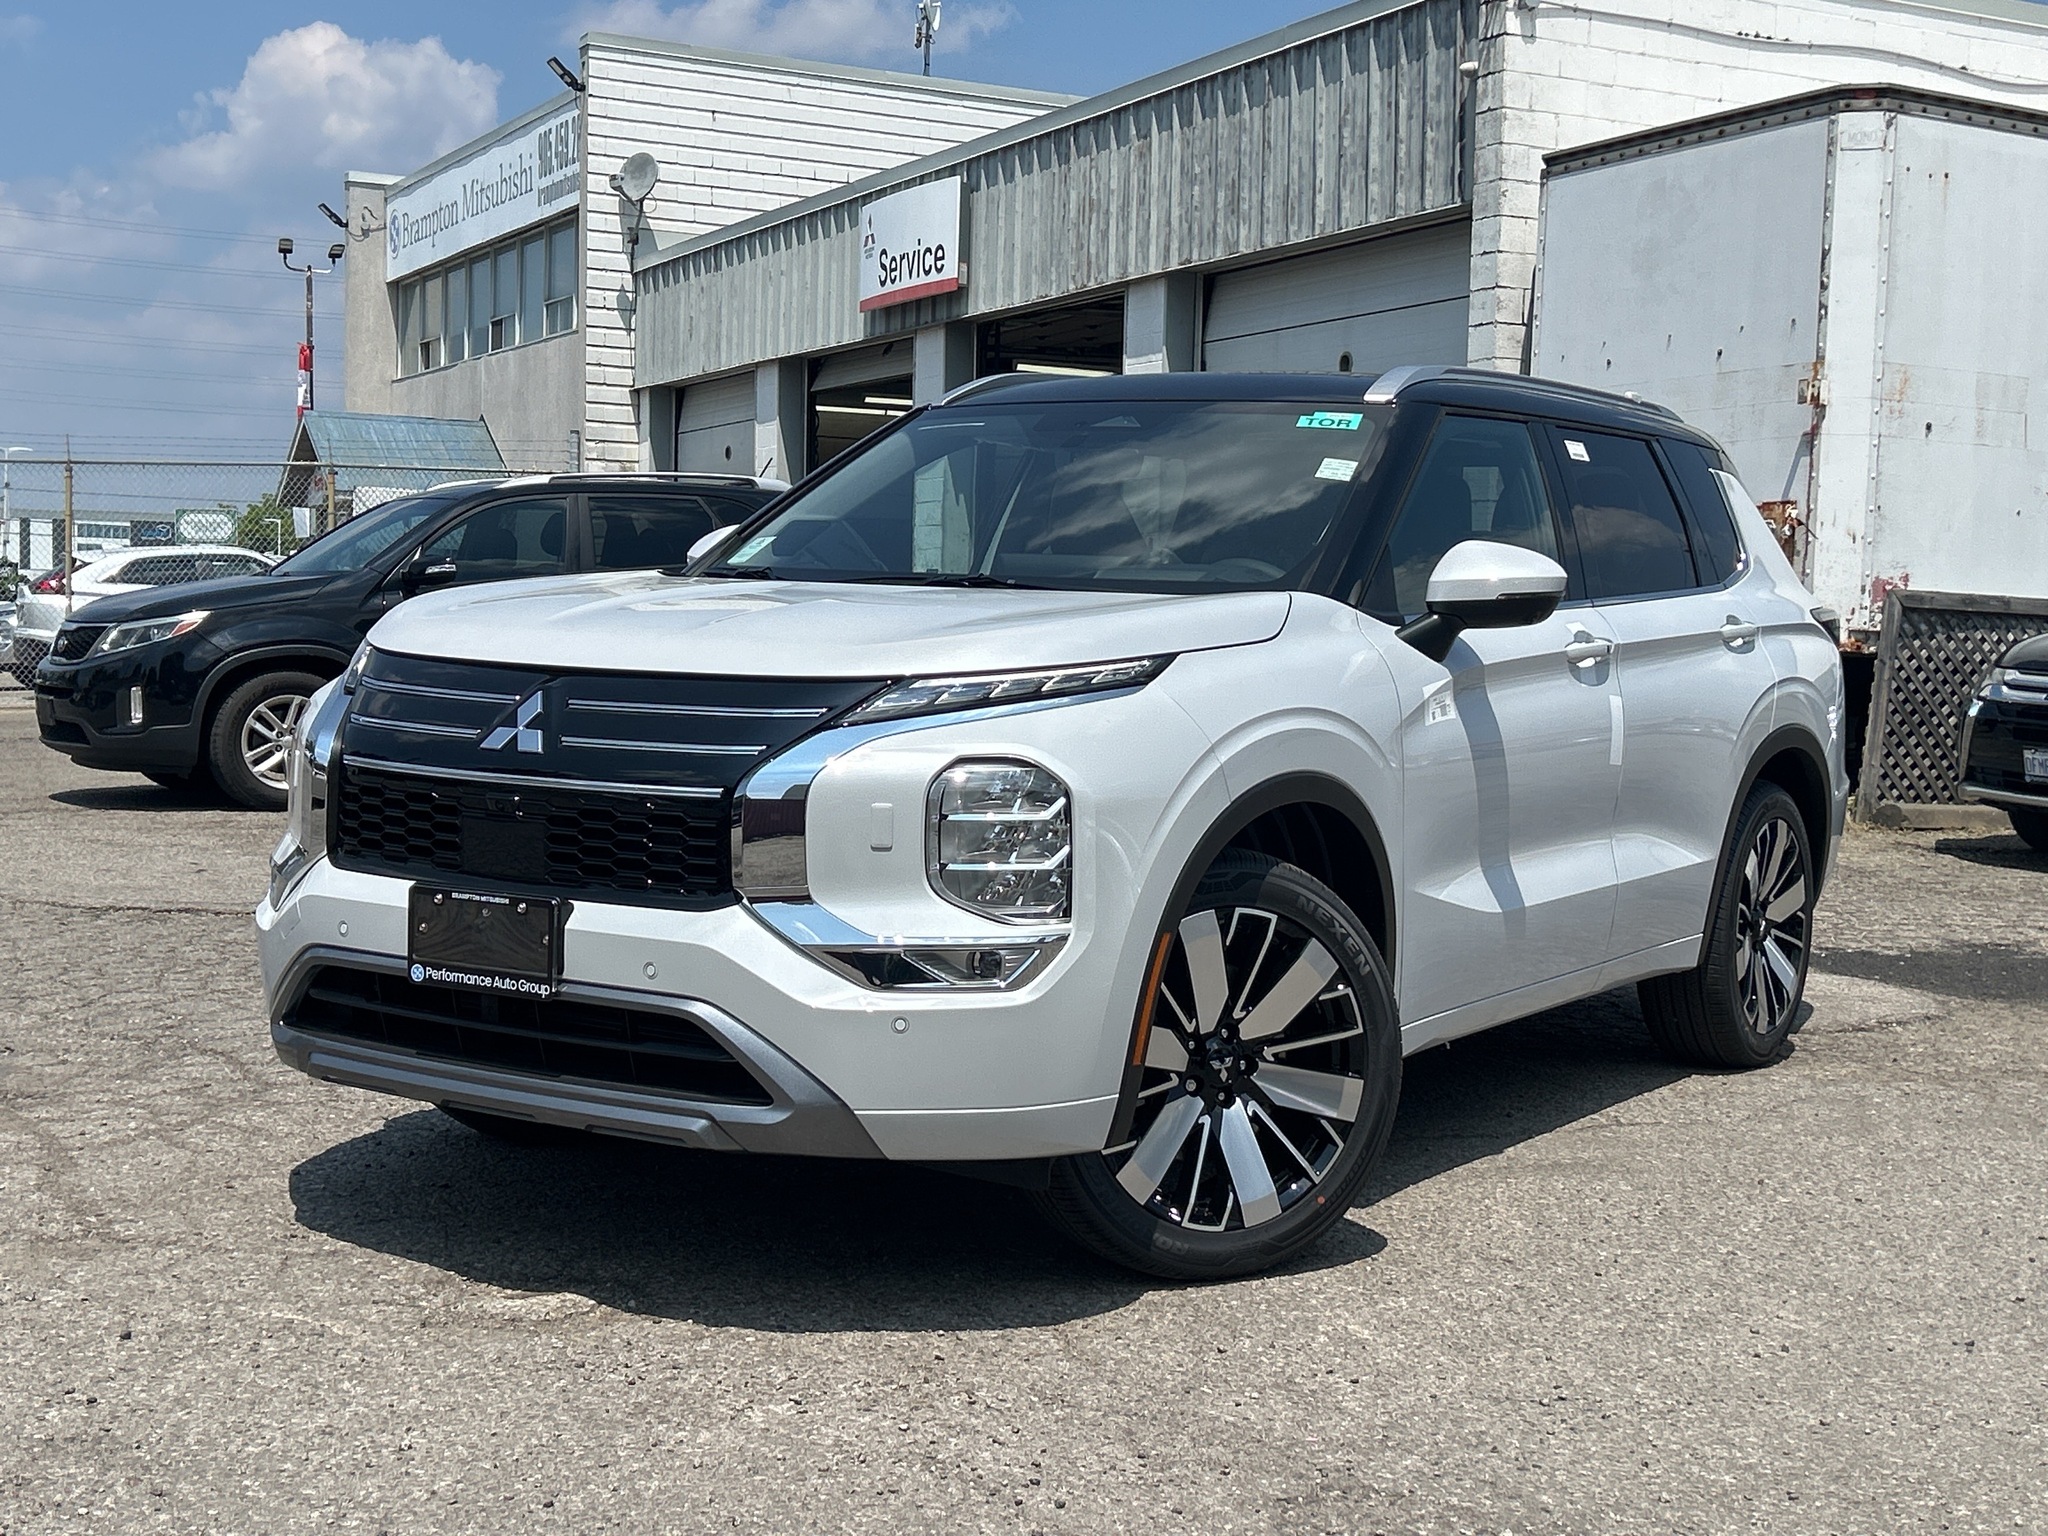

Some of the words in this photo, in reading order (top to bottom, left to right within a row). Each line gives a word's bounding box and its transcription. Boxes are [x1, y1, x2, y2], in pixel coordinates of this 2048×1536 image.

[402, 201, 459, 249] Brampton
[462, 153, 534, 222] Mitsubishi
[878, 238, 945, 288] Service
[1305, 417, 1353, 428] TOR
[1297, 897, 1371, 976] NEXEN
[425, 966, 492, 988] Performance
[492, 976, 518, 991] Auto
[518, 979, 550, 998] Group
